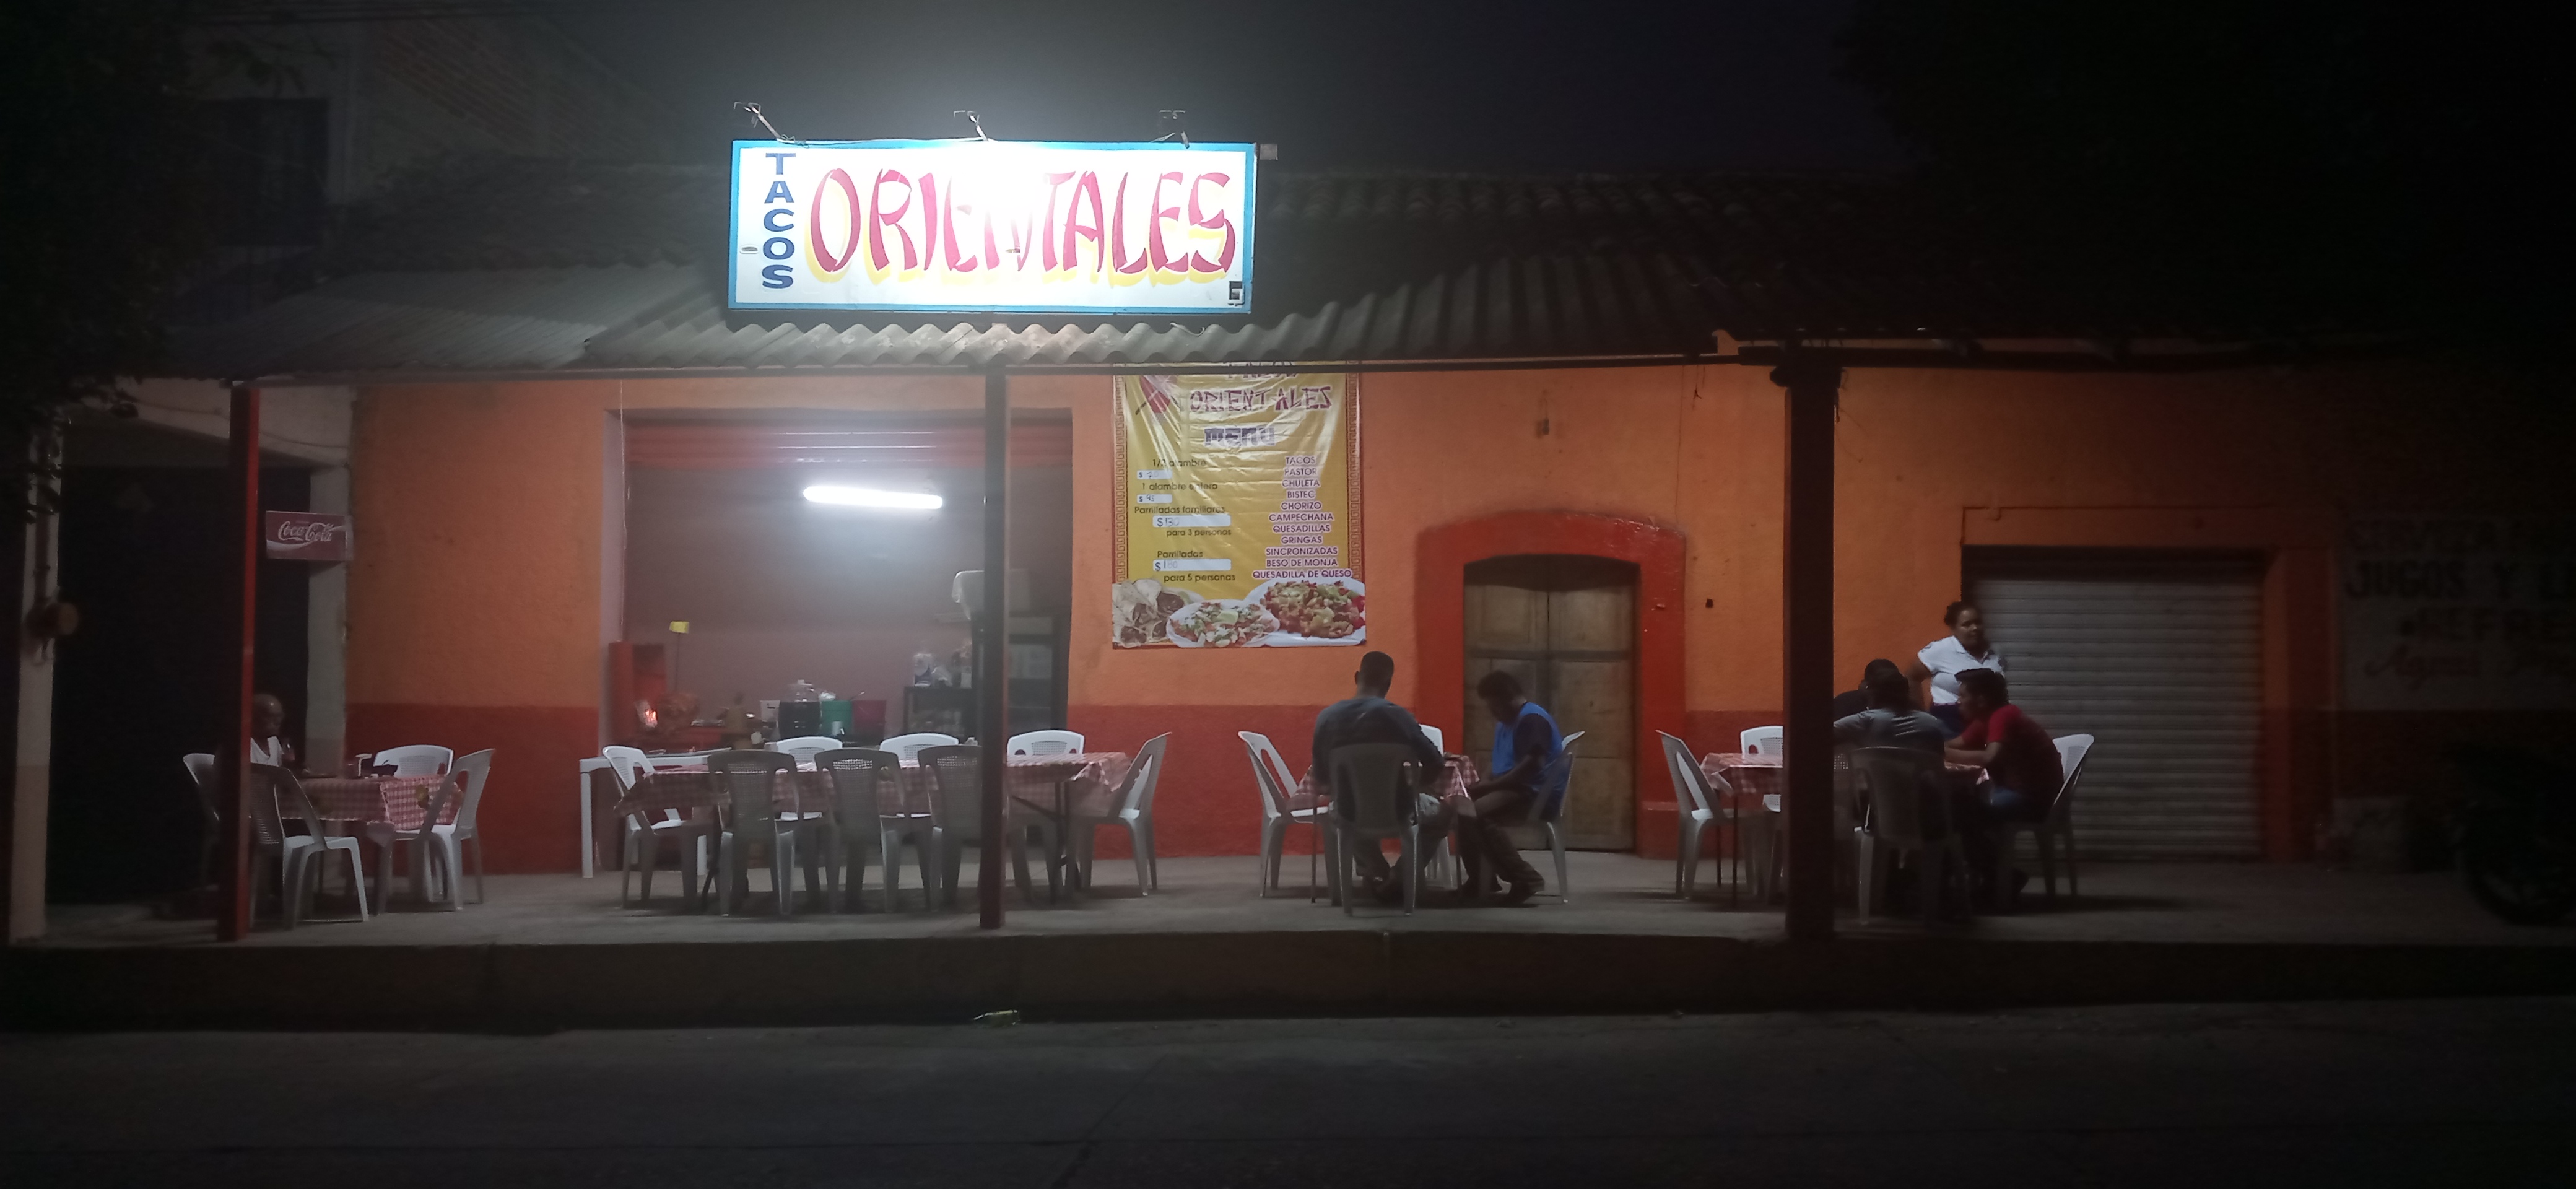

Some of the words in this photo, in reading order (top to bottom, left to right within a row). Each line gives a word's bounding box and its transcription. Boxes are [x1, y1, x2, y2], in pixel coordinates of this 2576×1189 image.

[762, 152, 796, 289] TACOS
[809, 168, 1237, 273] ORIENTALES
[1169, 458, 1206, 467] aambre
[1284, 468, 1317, 476] PASTOR
[1281, 502, 1321, 510] CHORIZO
[1281, 536, 1322, 544] GRINGAS
[1266, 547, 1338, 555] SINCRONIZADAS
[1253, 570, 1305, 578] QUESADILLA
[1321, 569, 1351, 577] QUESO
[1164, 575, 1185, 583] para
[2345, 560, 2465, 599] JUGOS
